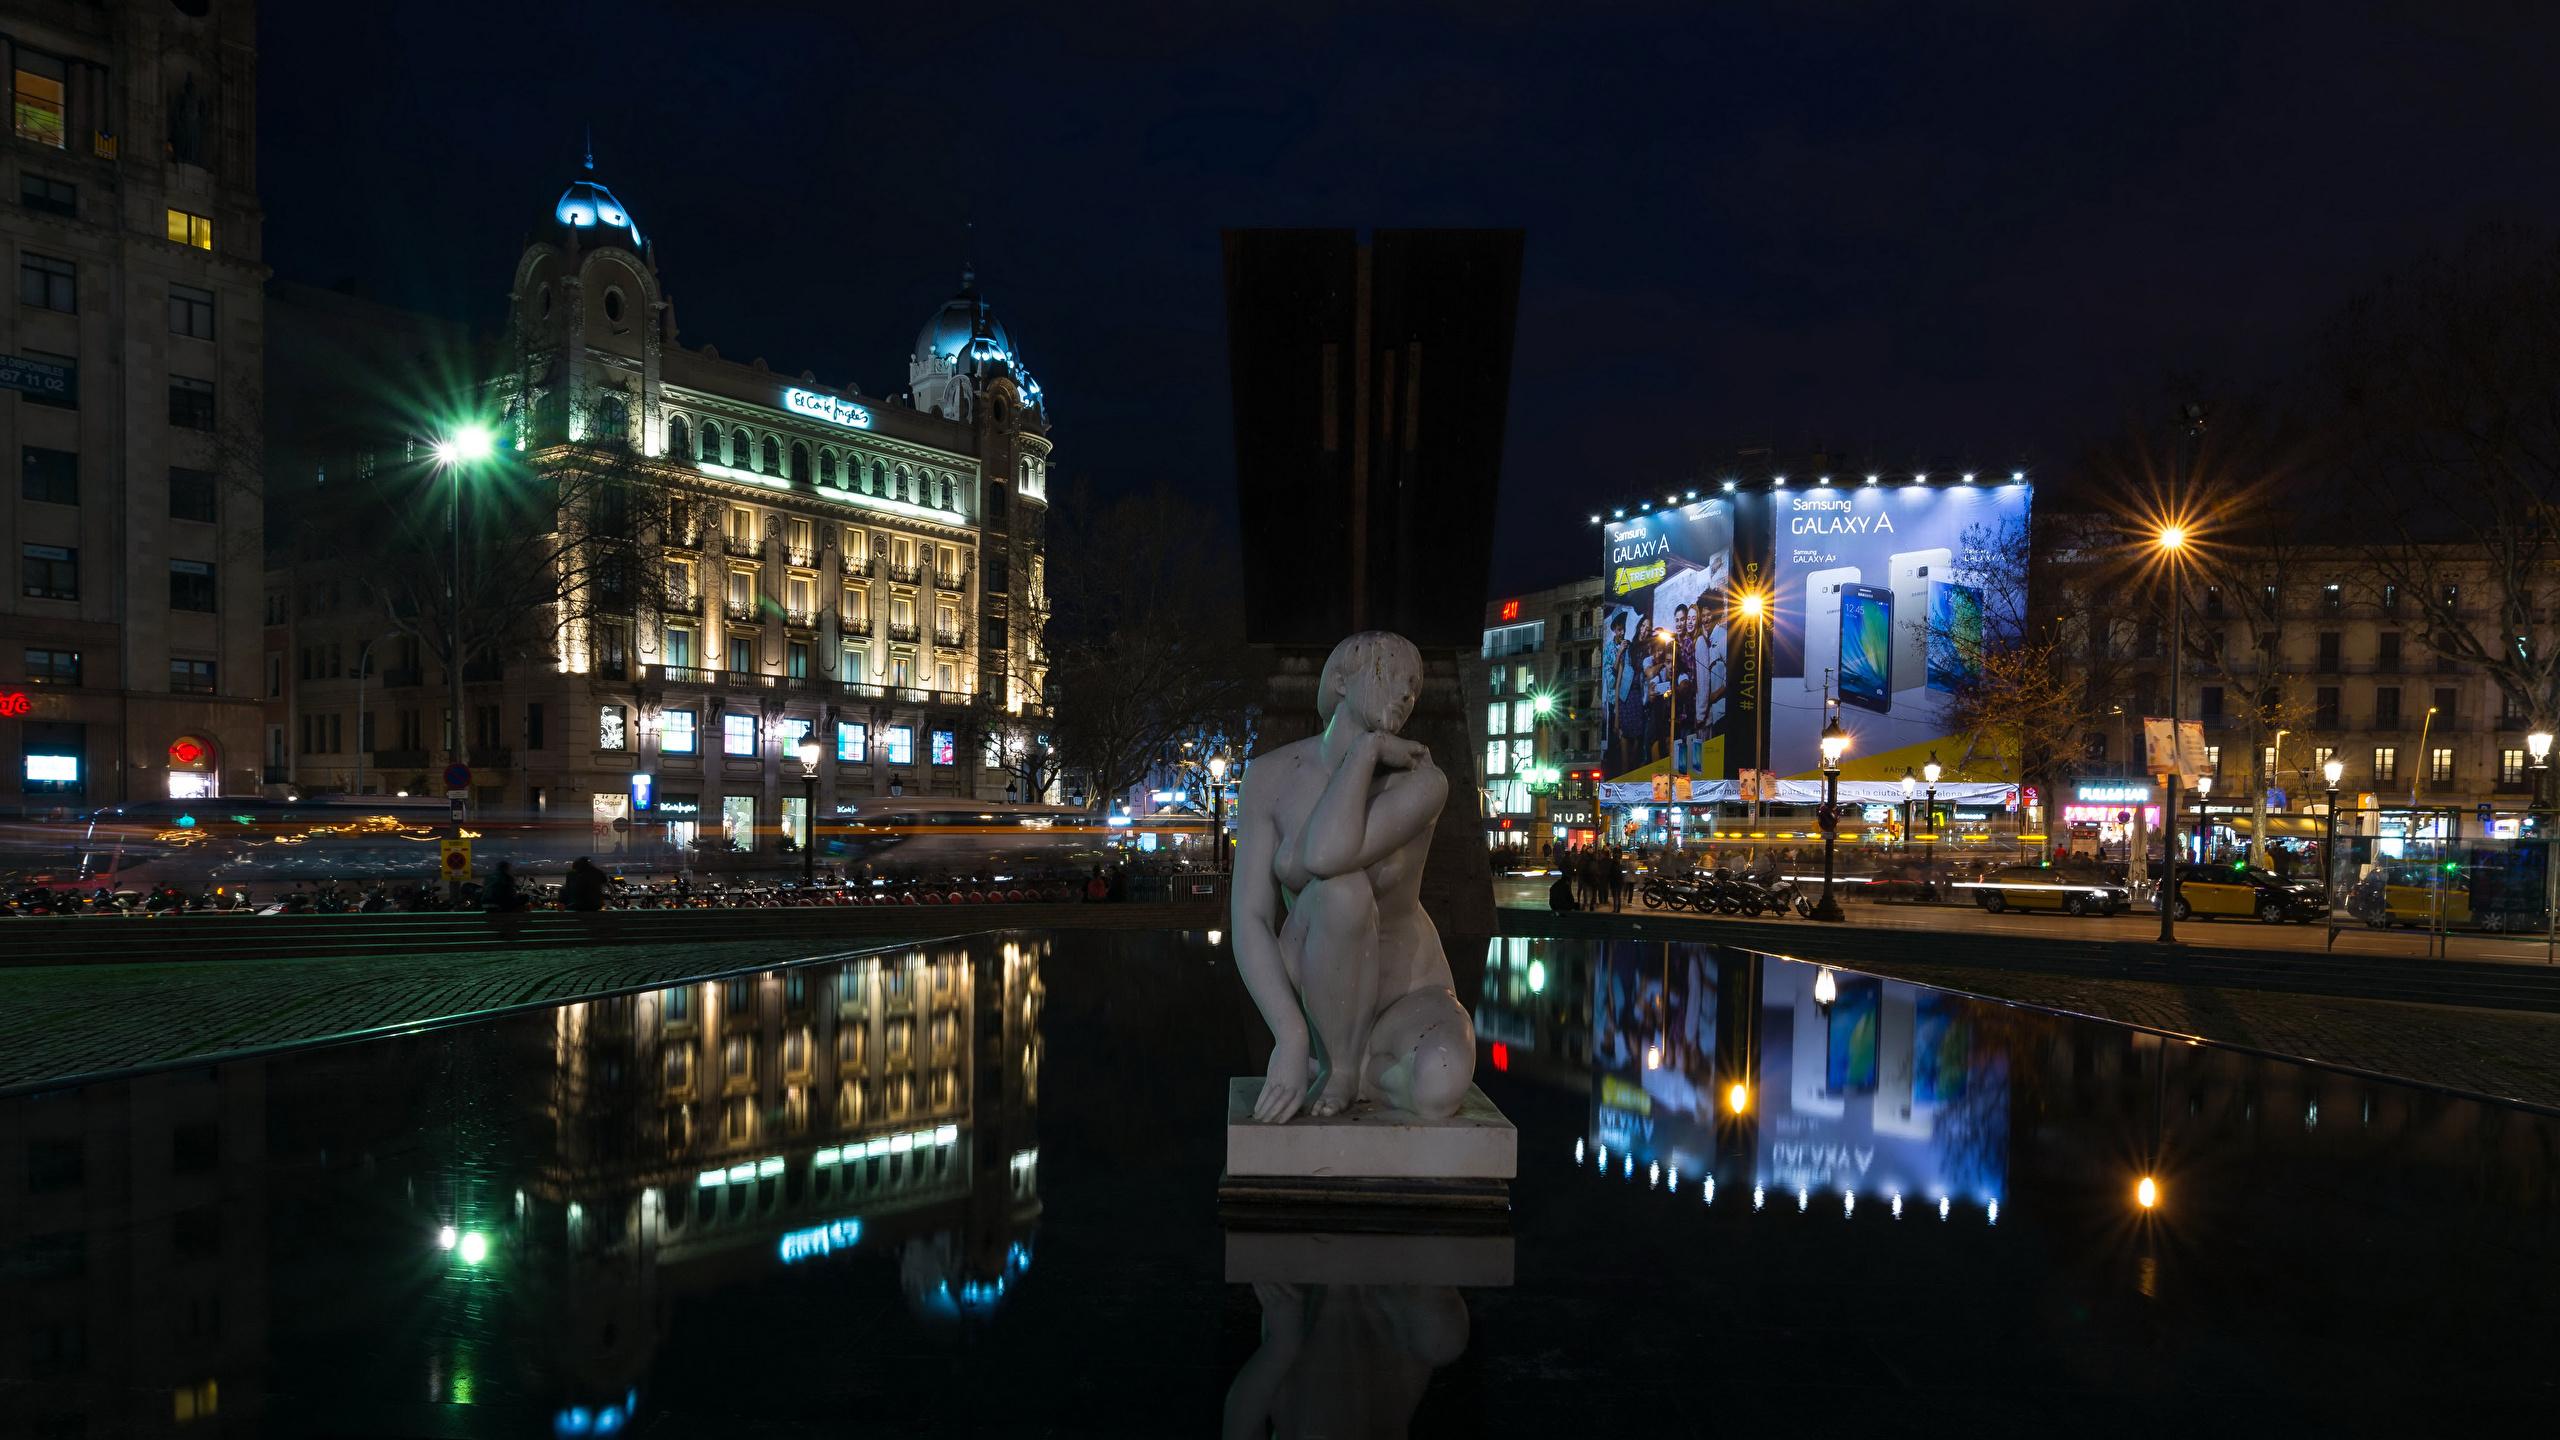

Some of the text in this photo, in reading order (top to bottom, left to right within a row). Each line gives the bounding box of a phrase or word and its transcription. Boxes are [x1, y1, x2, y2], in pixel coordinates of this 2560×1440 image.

[25, 373, 40, 387] 11
[45, 377, 64, 392] 02
[794, 392, 805, 407] El
[806, 396, 832, 414] Corte
[1793, 498, 1852, 513] Samsung
[1791, 511, 1895, 535] GALAXY A
[1614, 527, 1647, 542] Samsung
[1613, 533, 1670, 563] GALAXY A
[1793, 555, 1823, 563] GALAXY
